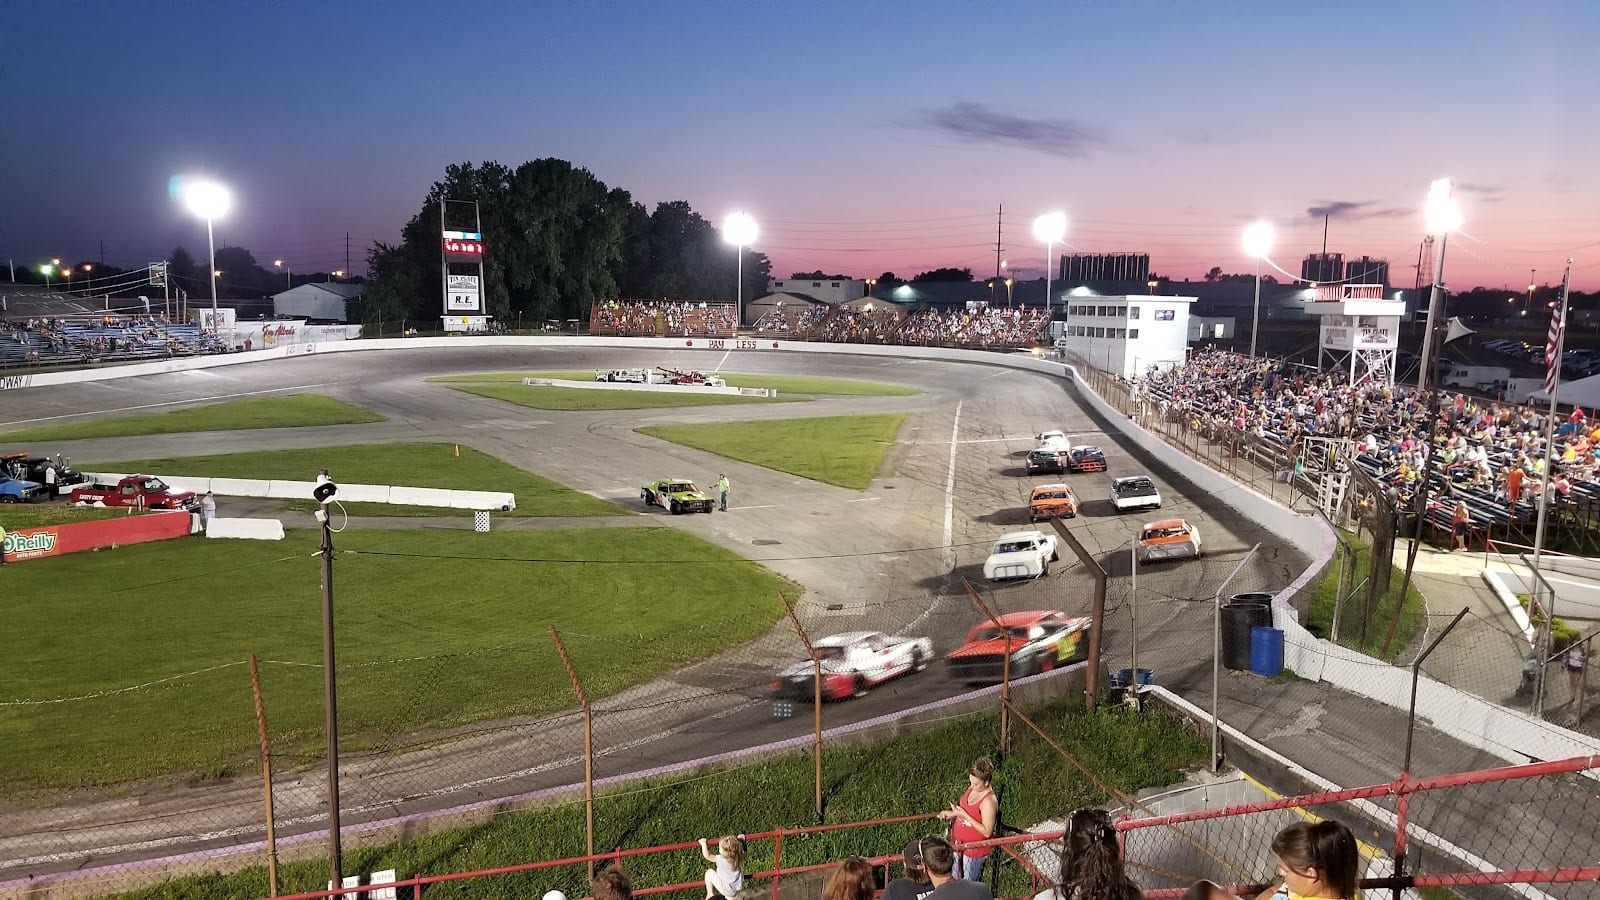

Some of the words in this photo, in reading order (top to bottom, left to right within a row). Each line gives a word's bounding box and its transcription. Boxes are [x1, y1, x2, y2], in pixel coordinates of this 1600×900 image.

[709, 340, 724, 349] PAY
[736, 340, 757, 349] LESS
[3, 533, 54, 552] O'Reilly
